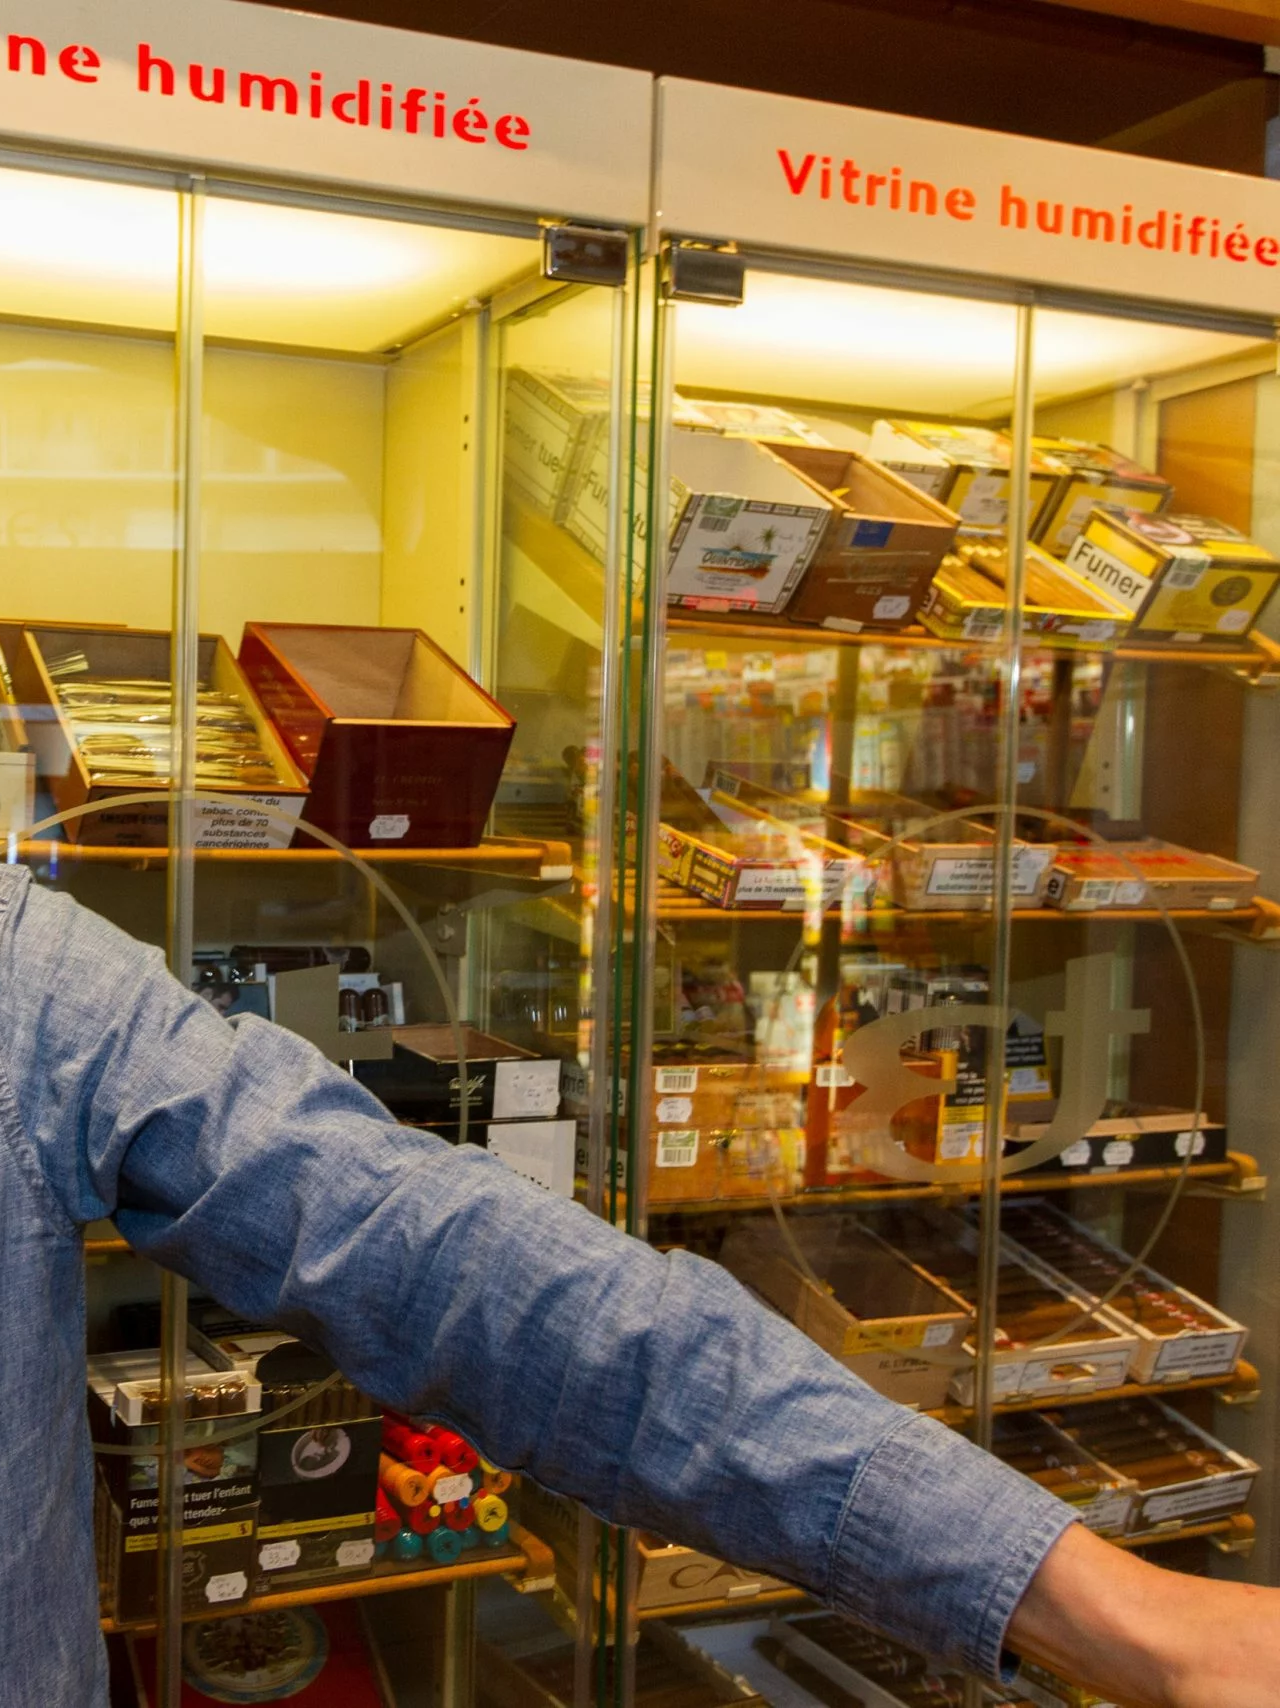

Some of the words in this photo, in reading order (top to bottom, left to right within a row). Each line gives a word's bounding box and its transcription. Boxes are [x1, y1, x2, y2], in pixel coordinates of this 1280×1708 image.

[137, 43, 530, 150] humidifiée
[777, 149, 976, 220] Vitrine
[1001, 184, 1279, 267] humidifiée
[1073, 541, 1144, 600] Fumer
[265, 797, 280, 806] du
[201, 807, 233, 816] tabac
[210, 818, 236, 828] plus
[238, 818, 253, 827] de
[255, 818, 269, 827] 70
[202, 829, 266, 838] substances
[130, 1497, 159, 1510] Fume
[191, 1489, 212, 1502] tuer
[213, 1484, 251, 1499] l'enfant
[129, 1516, 150, 1529] que
